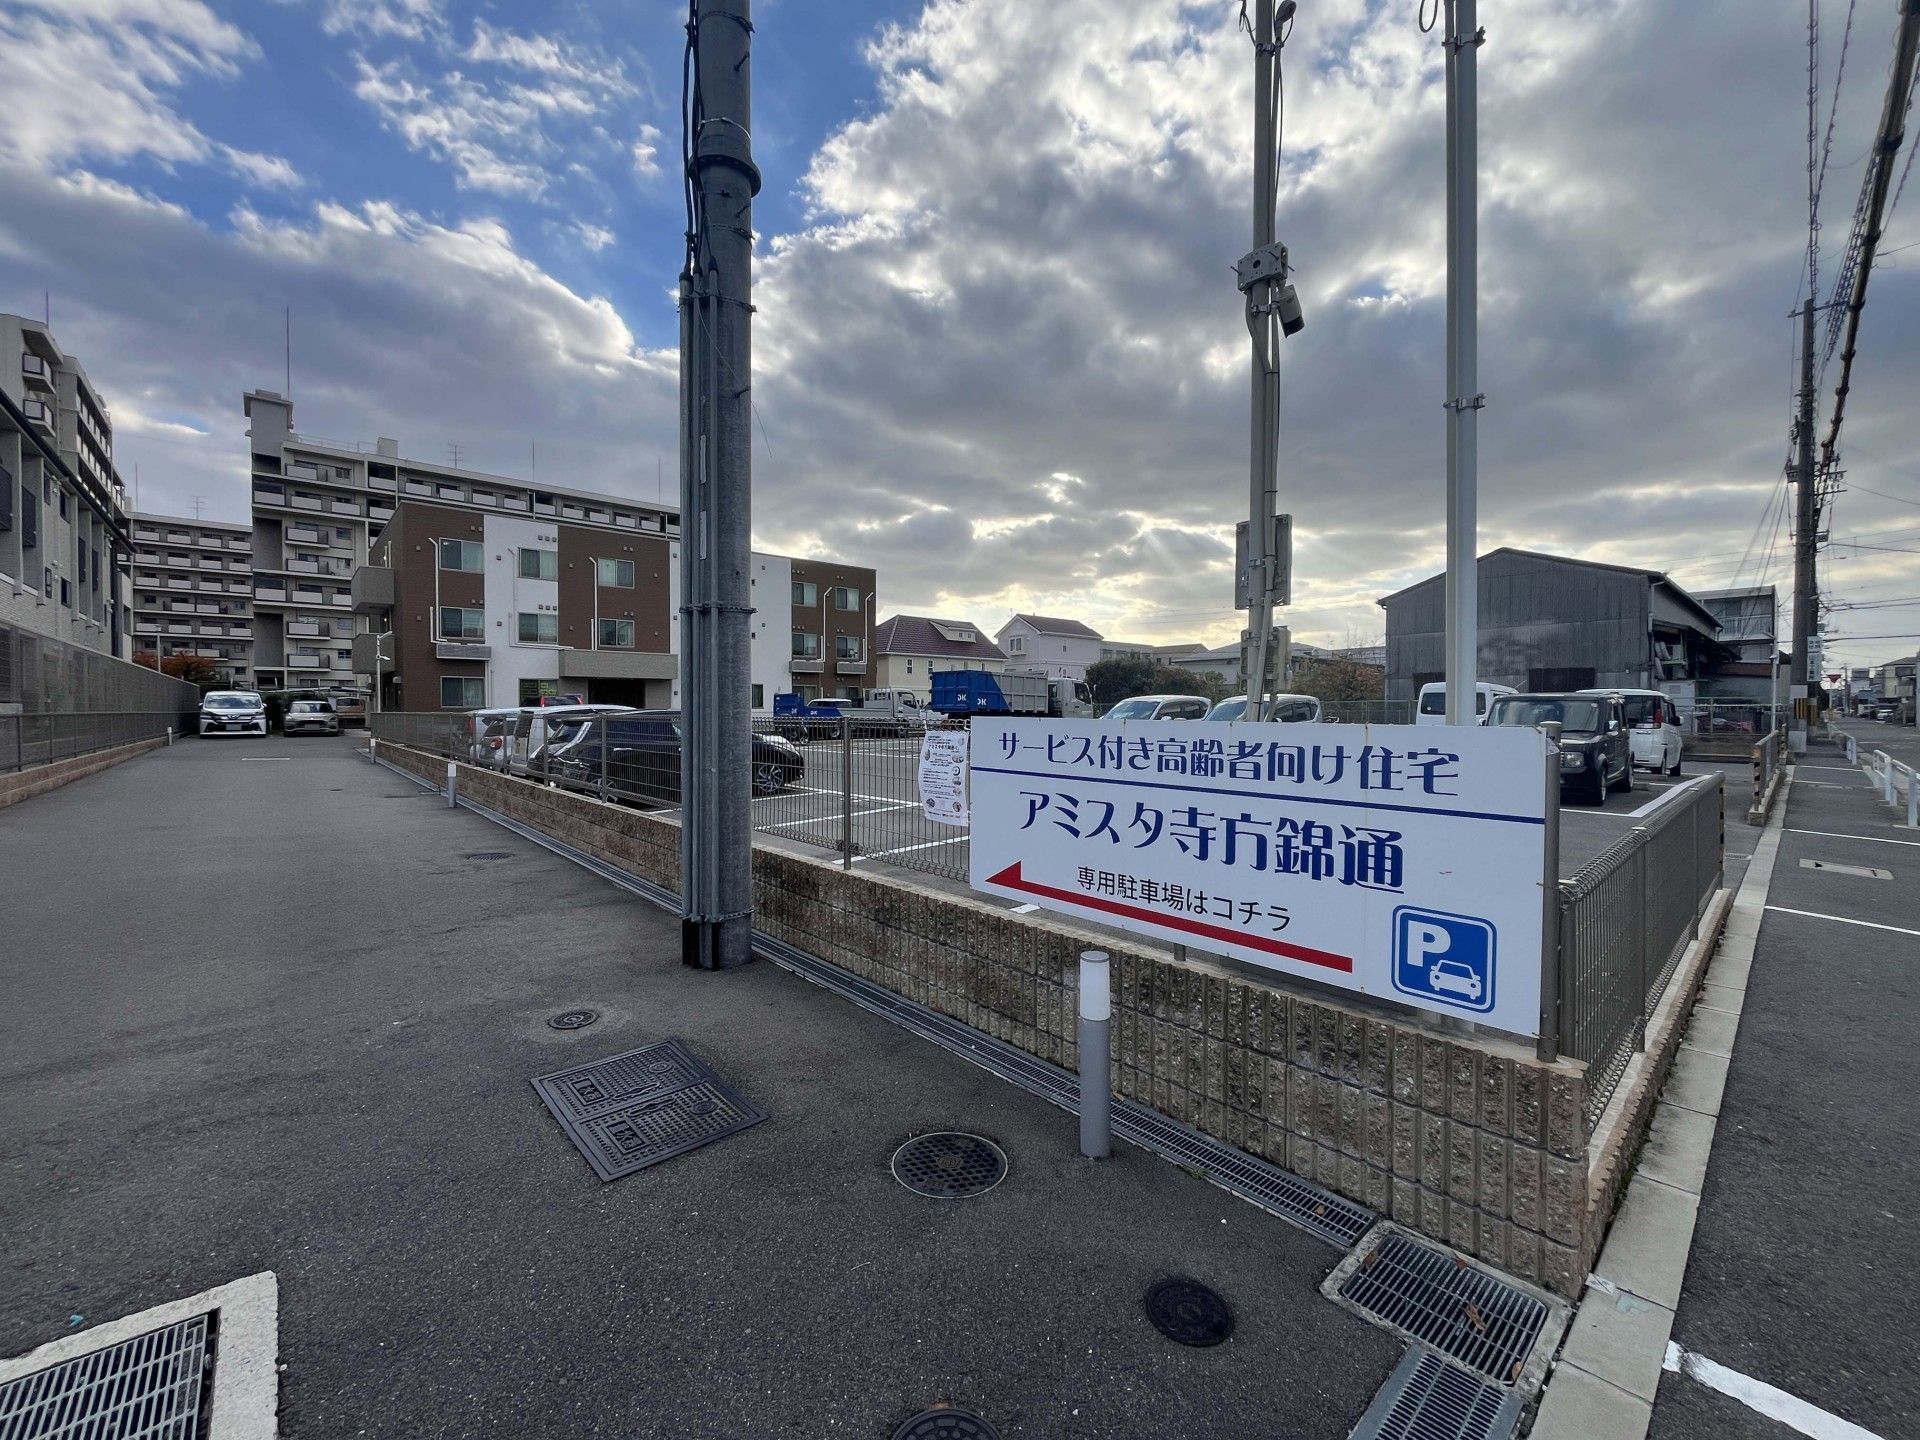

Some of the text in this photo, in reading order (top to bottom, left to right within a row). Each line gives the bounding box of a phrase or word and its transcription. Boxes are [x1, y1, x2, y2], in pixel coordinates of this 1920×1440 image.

[999, 732, 1460, 796] サービス付き高齢者向け住宅
[1019, 791, 1404, 894] アミスタ寺方錦通
[1077, 866, 1291, 931] 専用駐車場はコチラ
[1407, 922, 1451, 967] P
